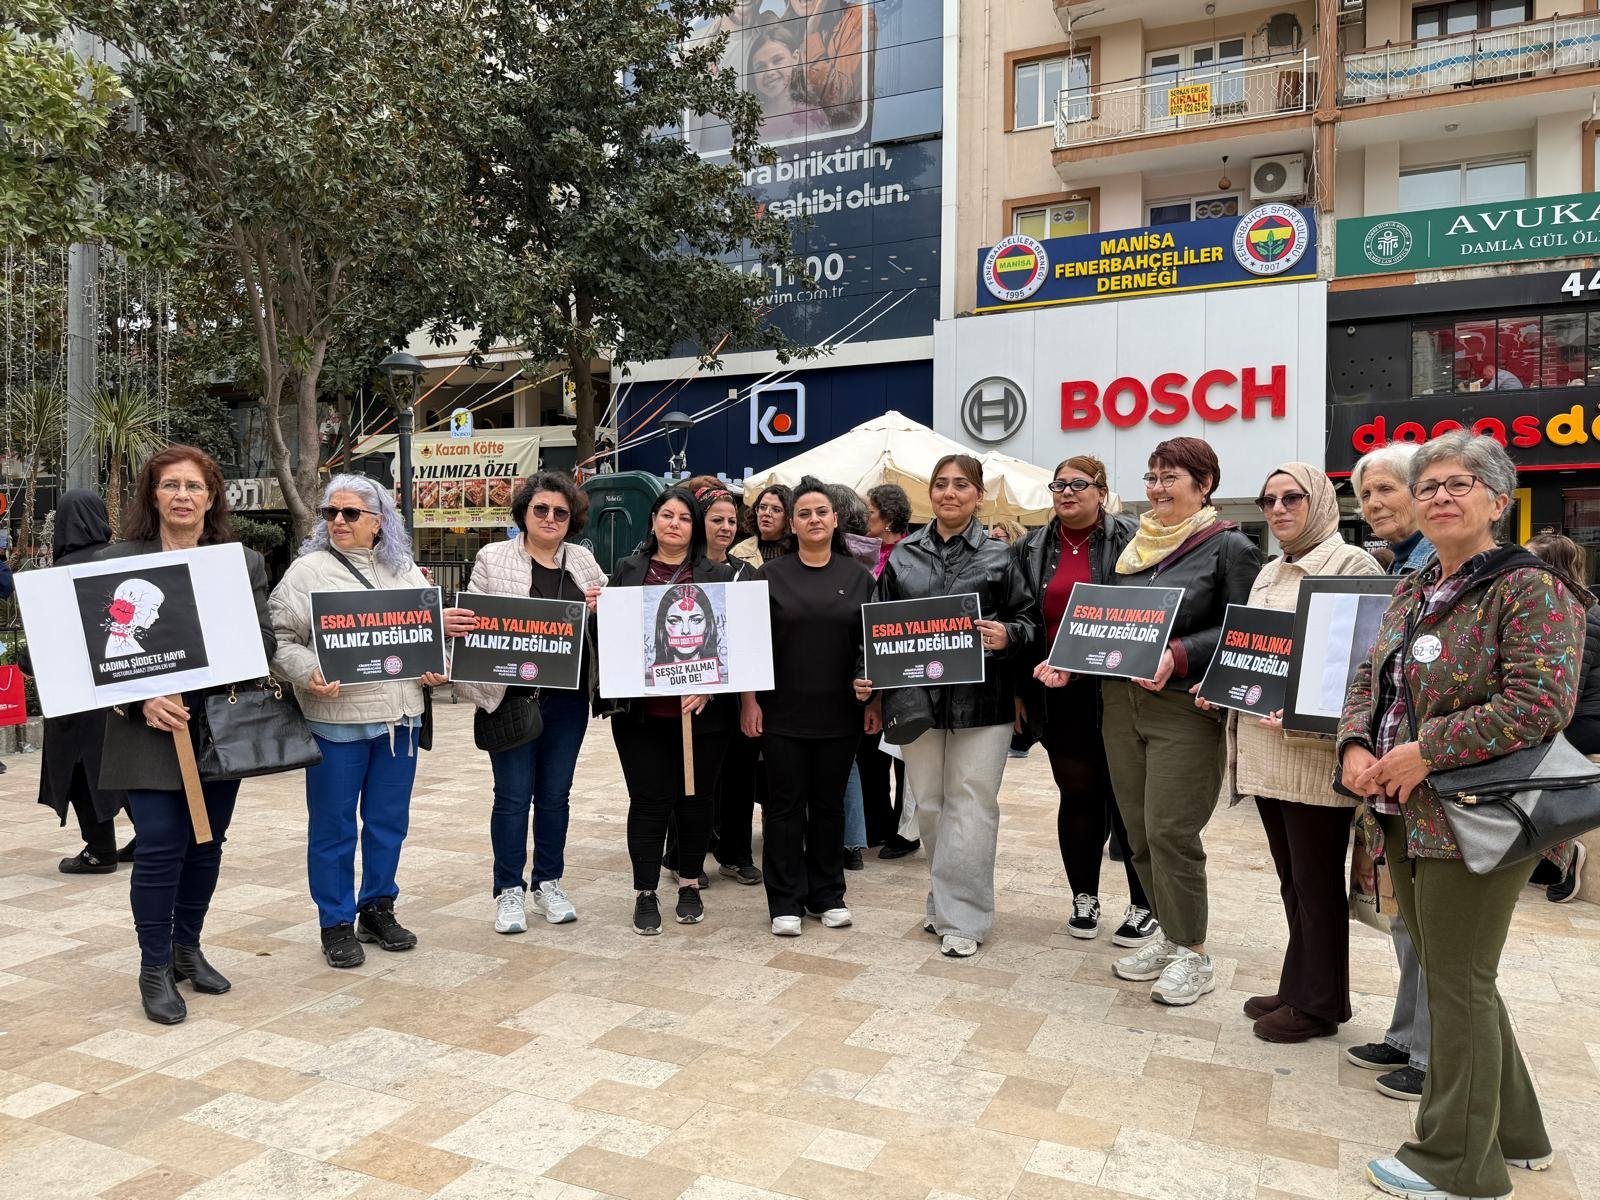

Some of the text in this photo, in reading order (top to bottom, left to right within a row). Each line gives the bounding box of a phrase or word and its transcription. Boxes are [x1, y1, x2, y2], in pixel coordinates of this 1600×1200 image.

[1170, 92, 1208, 106] KIRALIK
[776, 142, 893, 183] biriktirin,
[768, 185, 843, 219] sahibi
[846, 182, 911, 210] olun.
[1099, 231, 1175, 256] MANİSA
[1236, 207, 1268, 263] FENERBAHÇE
[1270, 205, 1297, 221] SPOR
[1460, 229, 1600, 256] DAMLA GÜL ÖL
[999, 259, 1032, 269] MANİSA
[1055, 246, 1224, 279] FENERBAHÇELİLER
[1259, 262, 1281, 272] 1907
[1096, 266, 1178, 293] DERNEĞİ
[1005, 289, 1025, 299] 1995
[1060, 364, 1287, 432] BOSCH
[435, 440, 505, 456] Kazan Köfte
[484, 460, 520, 477] ÖZEL
[320, 609, 433, 630] ESRA YALINKAYA
[1073, 605, 1168, 625] ESRA YALINKAYA
[322, 624, 433, 650] YALNIZ DEĞİLDİR
[473, 616, 575, 637] SRA YALINKAYA
[872, 616, 973, 638] ESRA YALINKAYA
[1068, 621, 1160, 643] YALNIZ DEĞİLDİR
[465, 634, 572, 655] YALNIZ DEĞİLDİR
[872, 631, 974, 656] YALNIZ DEĞİLDİR
[1224, 630, 1293, 656] ESRA YALINKA
[99, 649, 187, 673] KADINA ŞİDDETE HAYIR
[685, 661, 716, 674] KALMA!
[1219, 650, 1290, 678] YALNIZ DEĞİLD
[670, 673, 703, 686] DUR DE!
